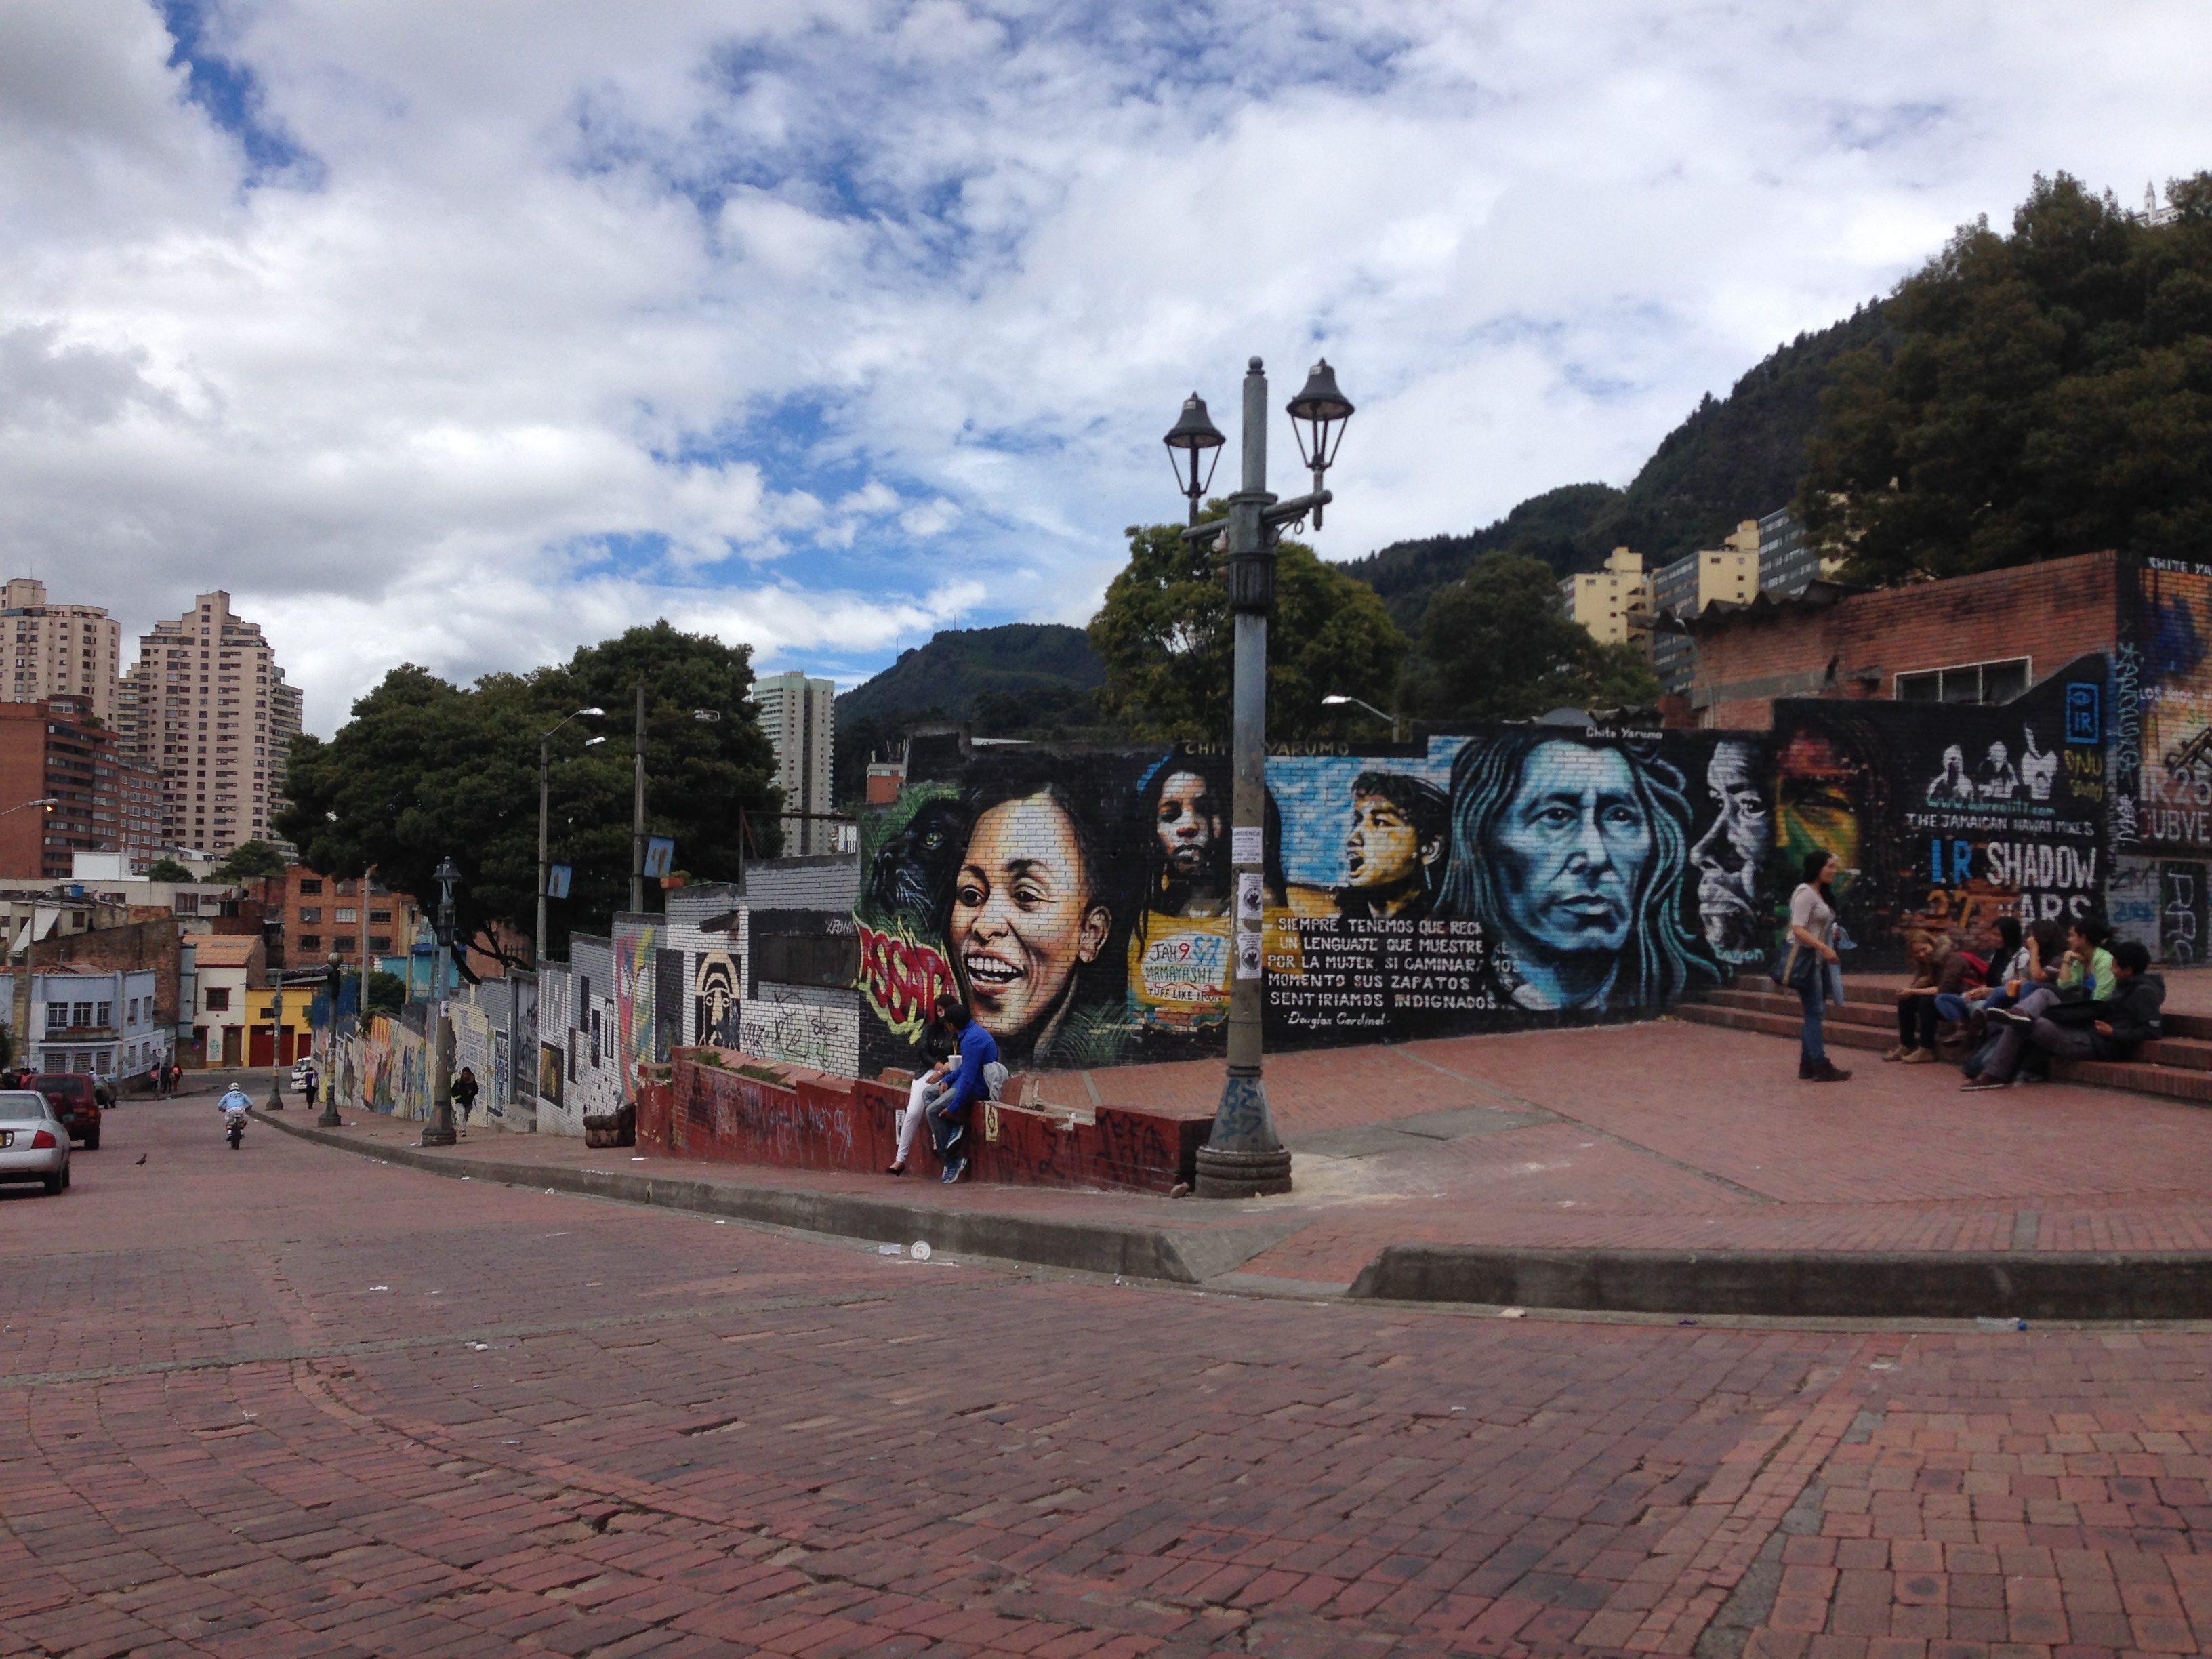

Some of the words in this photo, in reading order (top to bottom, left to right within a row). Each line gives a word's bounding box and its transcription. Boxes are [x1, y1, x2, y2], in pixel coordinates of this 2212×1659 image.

[1906, 813, 1937, 827] THE
[1942, 814, 2007, 831] JAMAICAN
[1986, 841, 2097, 889] SHADOW
[1278, 918, 1340, 933] SIEMPRE
[1347, 919, 1414, 933] TENEMOS
[1418, 920, 1446, 935] QUE
[1279, 937, 1300, 950] UN
[1303, 937, 1378, 951] LENGUAJE
[1386, 938, 1412, 952] QUE
[1419, 939, 1483, 954] MUESTRE
[1267, 954, 1295, 968] POR
[1301, 954, 1320, 969] LA
[1384, 956, 1399, 970] SI
[1267, 973, 1345, 987] MOMENTO
[1353, 974, 1384, 988] SUS
[1391, 975, 1470, 991] ZAPATOS
[1148, 988, 1170, 997] TUFF
[1173, 990, 1193, 1000] LIKE
[1270, 992, 1385, 1007] SENTIRIAMOS
[1394, 994, 1497, 1010] INDIGNADOS
